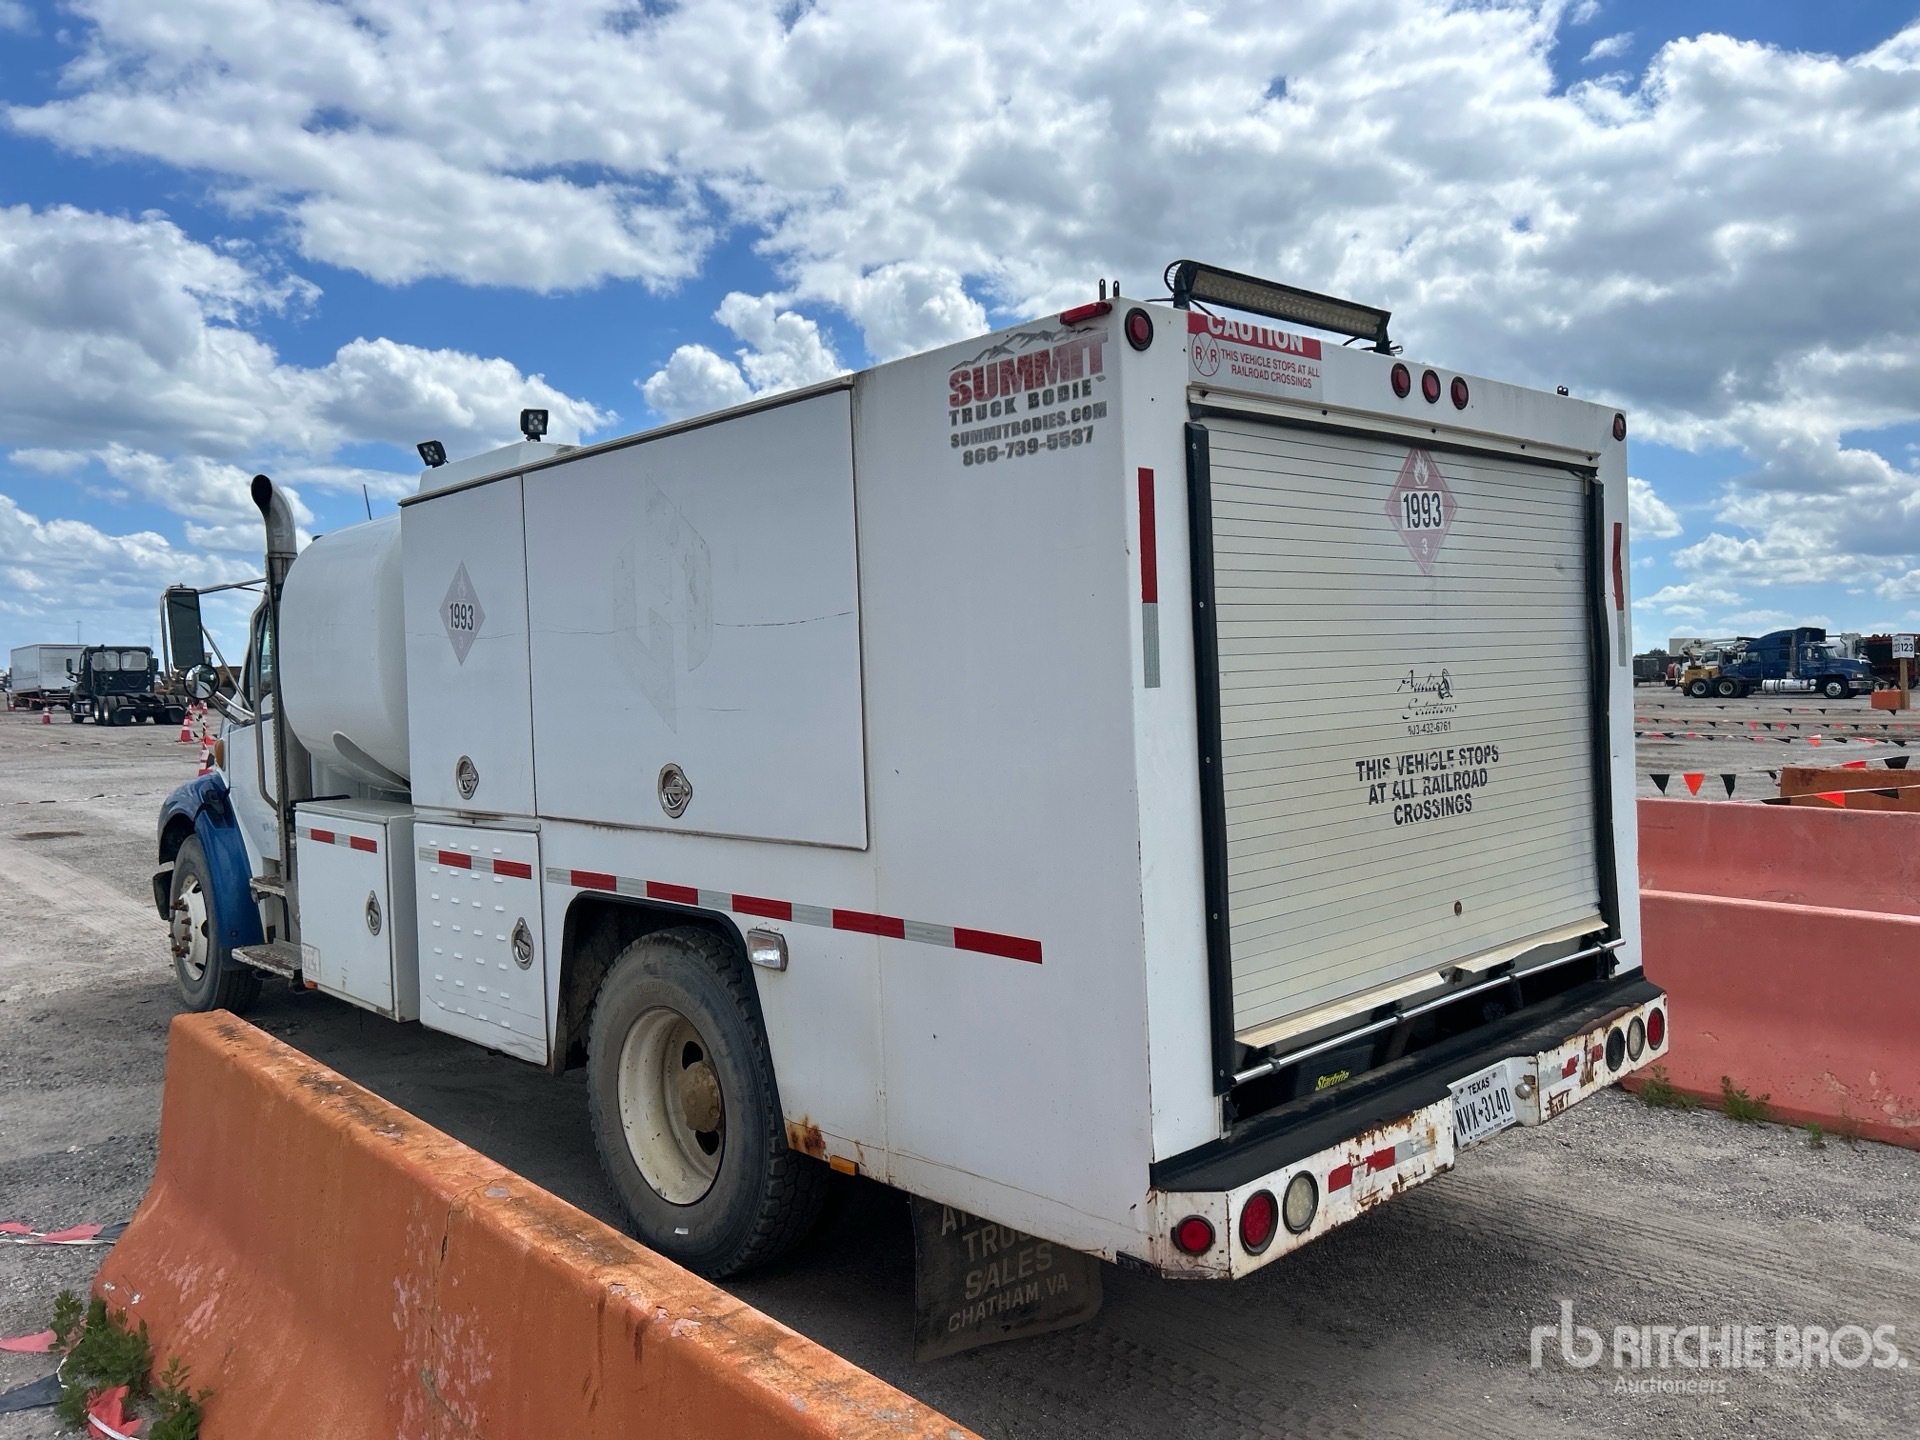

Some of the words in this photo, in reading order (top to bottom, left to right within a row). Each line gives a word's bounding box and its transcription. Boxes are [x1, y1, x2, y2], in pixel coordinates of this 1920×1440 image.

[1207, 316, 1304, 352] CAUTION
[949, 332, 1108, 407] SUMMIT
[1220, 349, 1239, 362] THIS
[1240, 352, 1270, 369] VEHICLE
[1273, 359, 1296, 374] STOPS
[1298, 365, 1306, 375] AT
[1308, 367, 1320, 378] ALL
[1231, 364, 1269, 381] RAILROAD
[1270, 372, 1312, 389] CROSSINGS
[949, 397, 1017, 427] TRUCK
[1028, 375, 1107, 410] BODIE
[951, 401, 1108, 449] SUMMITBODIES.COM
[963, 425, 1094, 467] 866-739-5537
[1403, 492, 1442, 529] 1993
[1421, 537, 1428, 555] 3
[450, 602, 474, 631] 1993
[1900, 642, 1914, 652] 123
[1355, 756, 1391, 782] THIS
[1396, 749, 1455, 776] VEHICLE
[1458, 744, 1500, 767] STOPS
[1368, 782, 1387, 806] AT
[1391, 777, 1418, 802] ALL
[1422, 768, 1488, 796] RAILROAD
[1393, 793, 1473, 826] CROSSINGS
[1467, 1077, 1490, 1096] TEXAS
[962, 1223, 1032, 1263] TRU
[965, 1242, 1053, 1300] SALES
[1046, 1272, 1069, 1296] VA
